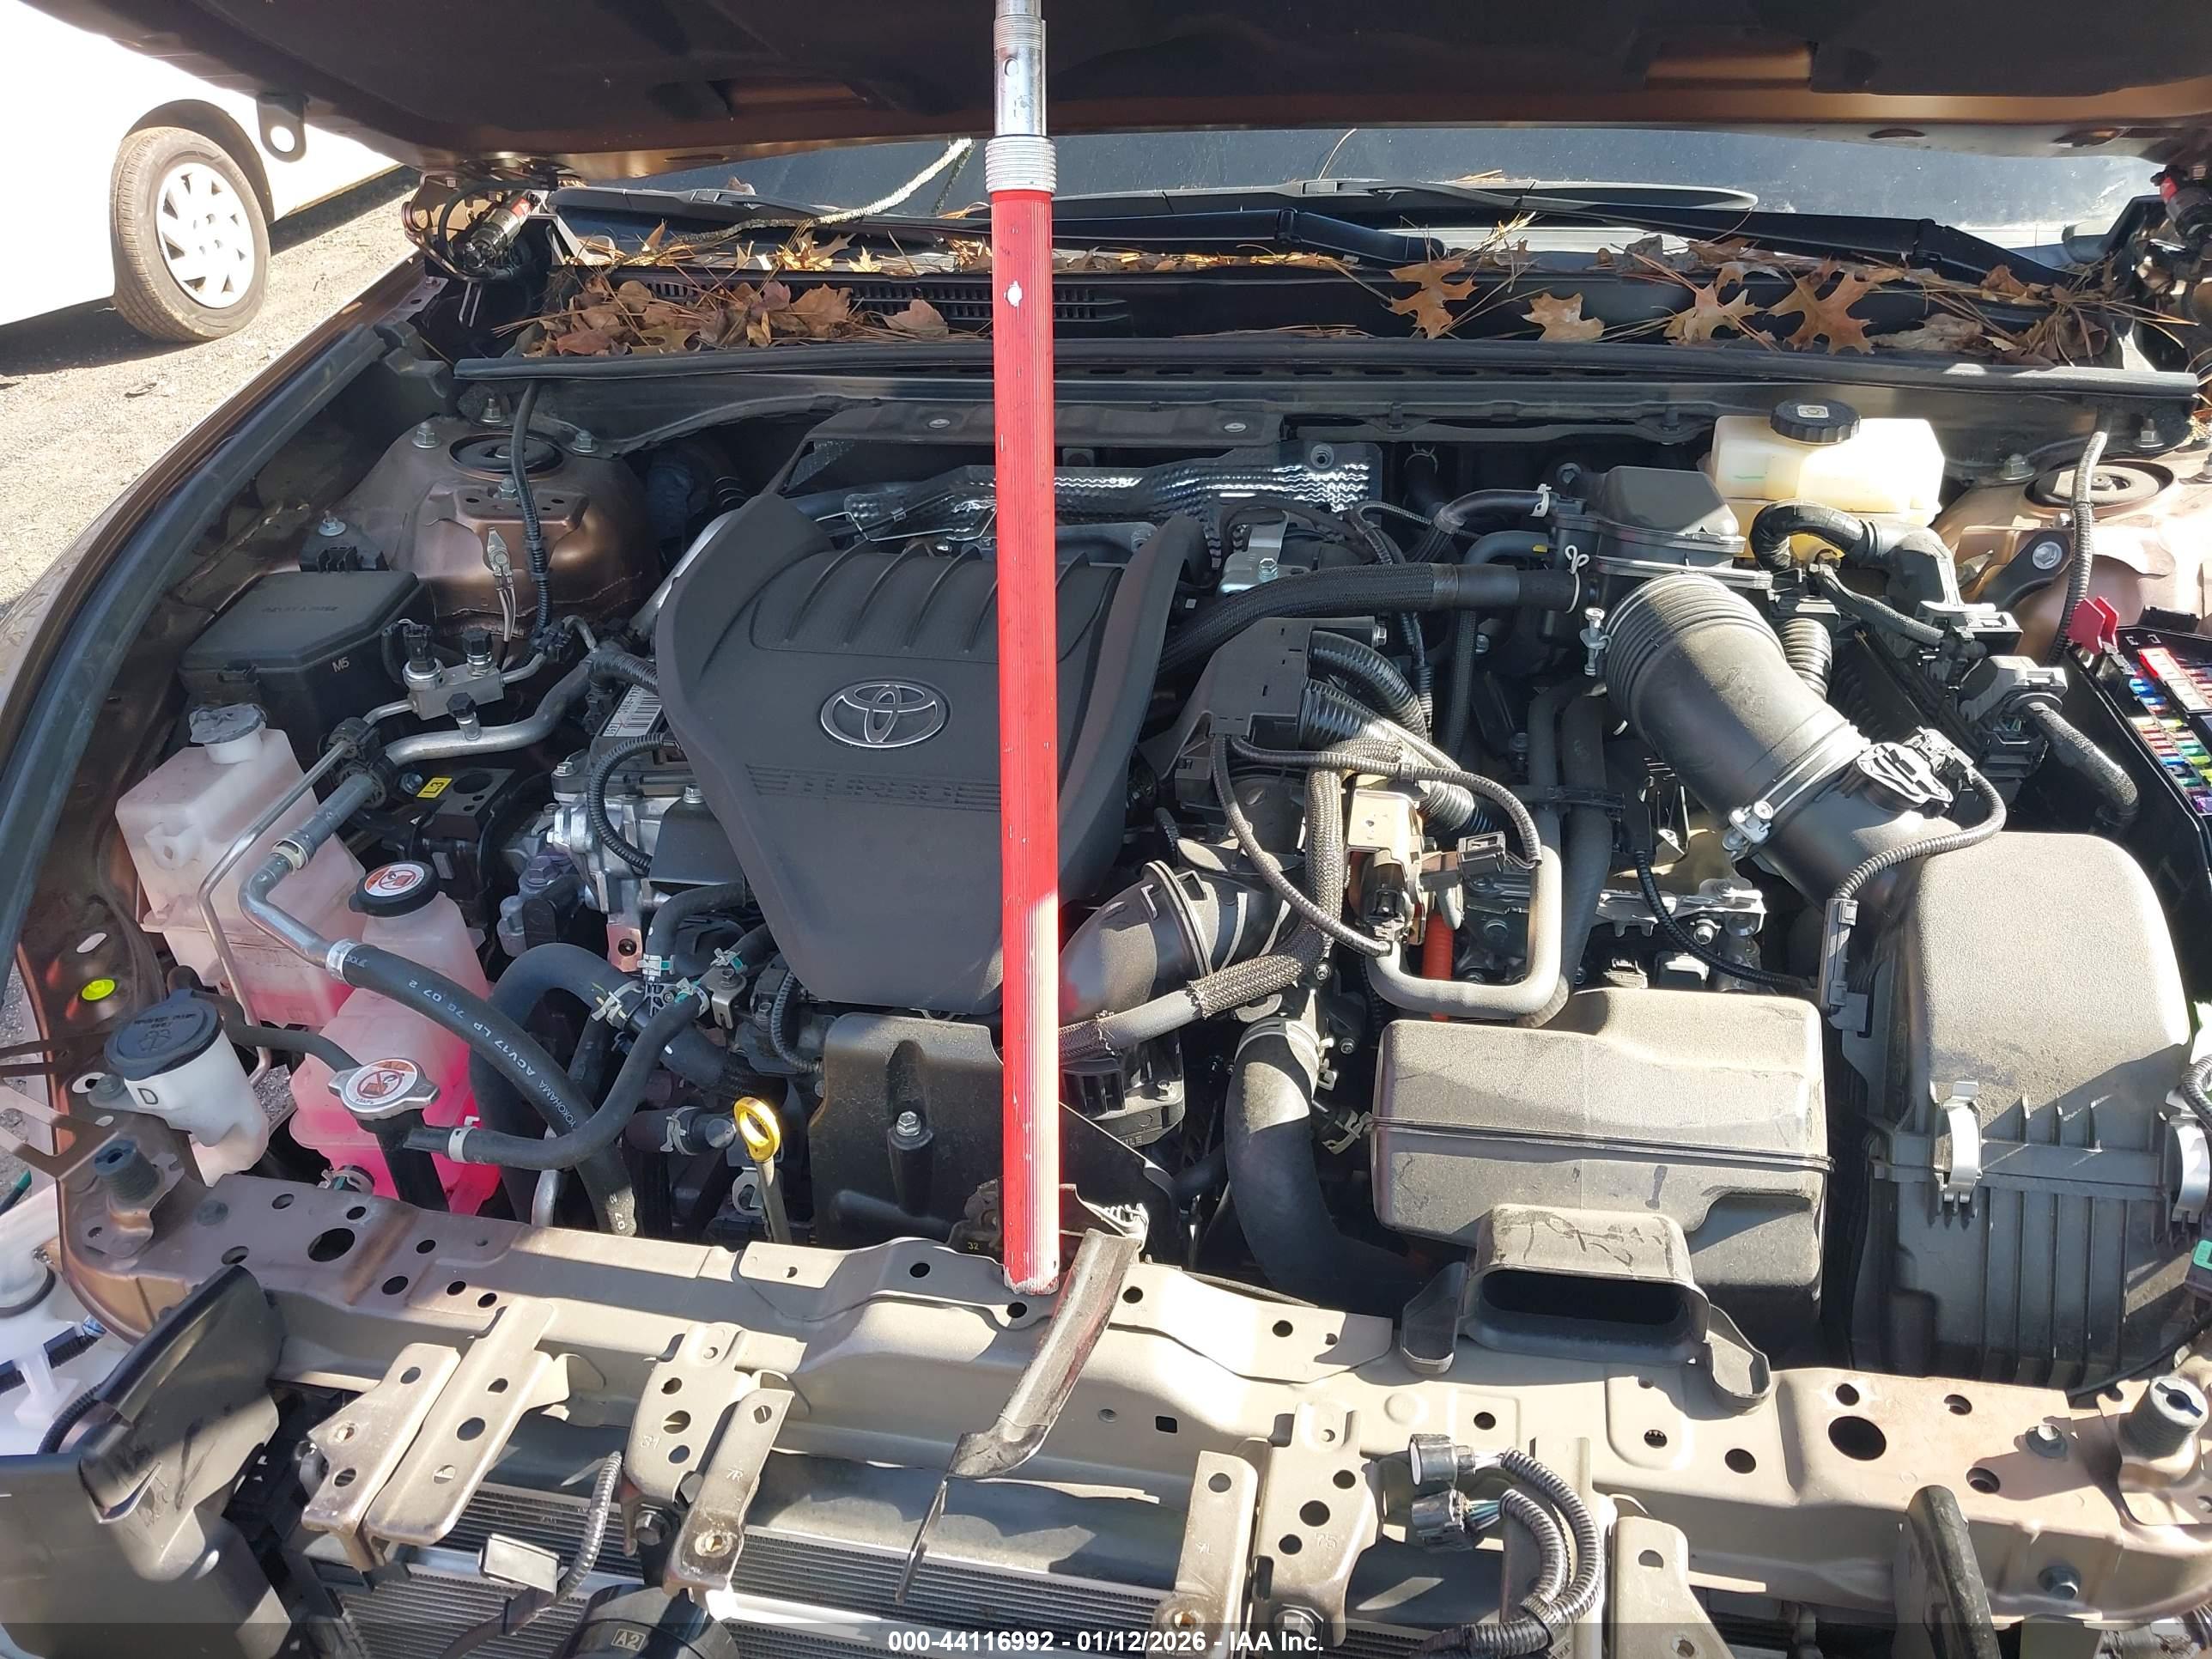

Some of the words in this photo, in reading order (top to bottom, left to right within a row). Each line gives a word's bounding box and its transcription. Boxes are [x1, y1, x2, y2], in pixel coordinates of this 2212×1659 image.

[331, 656, 349, 672] M5
[423, 782, 445, 793] L3
[408, 979, 419, 988] 2
[473, 1022, 492, 1037] LP
[495, 1040, 536, 1076] ACV17
[137, 1087, 159, 1105] D
[538, 1079, 577, 1127] YOKOHAMA
[609, 1193, 618, 1206] 2
[967, 1242, 980, 1250] 32
[614, 1632, 640, 1648] A2
